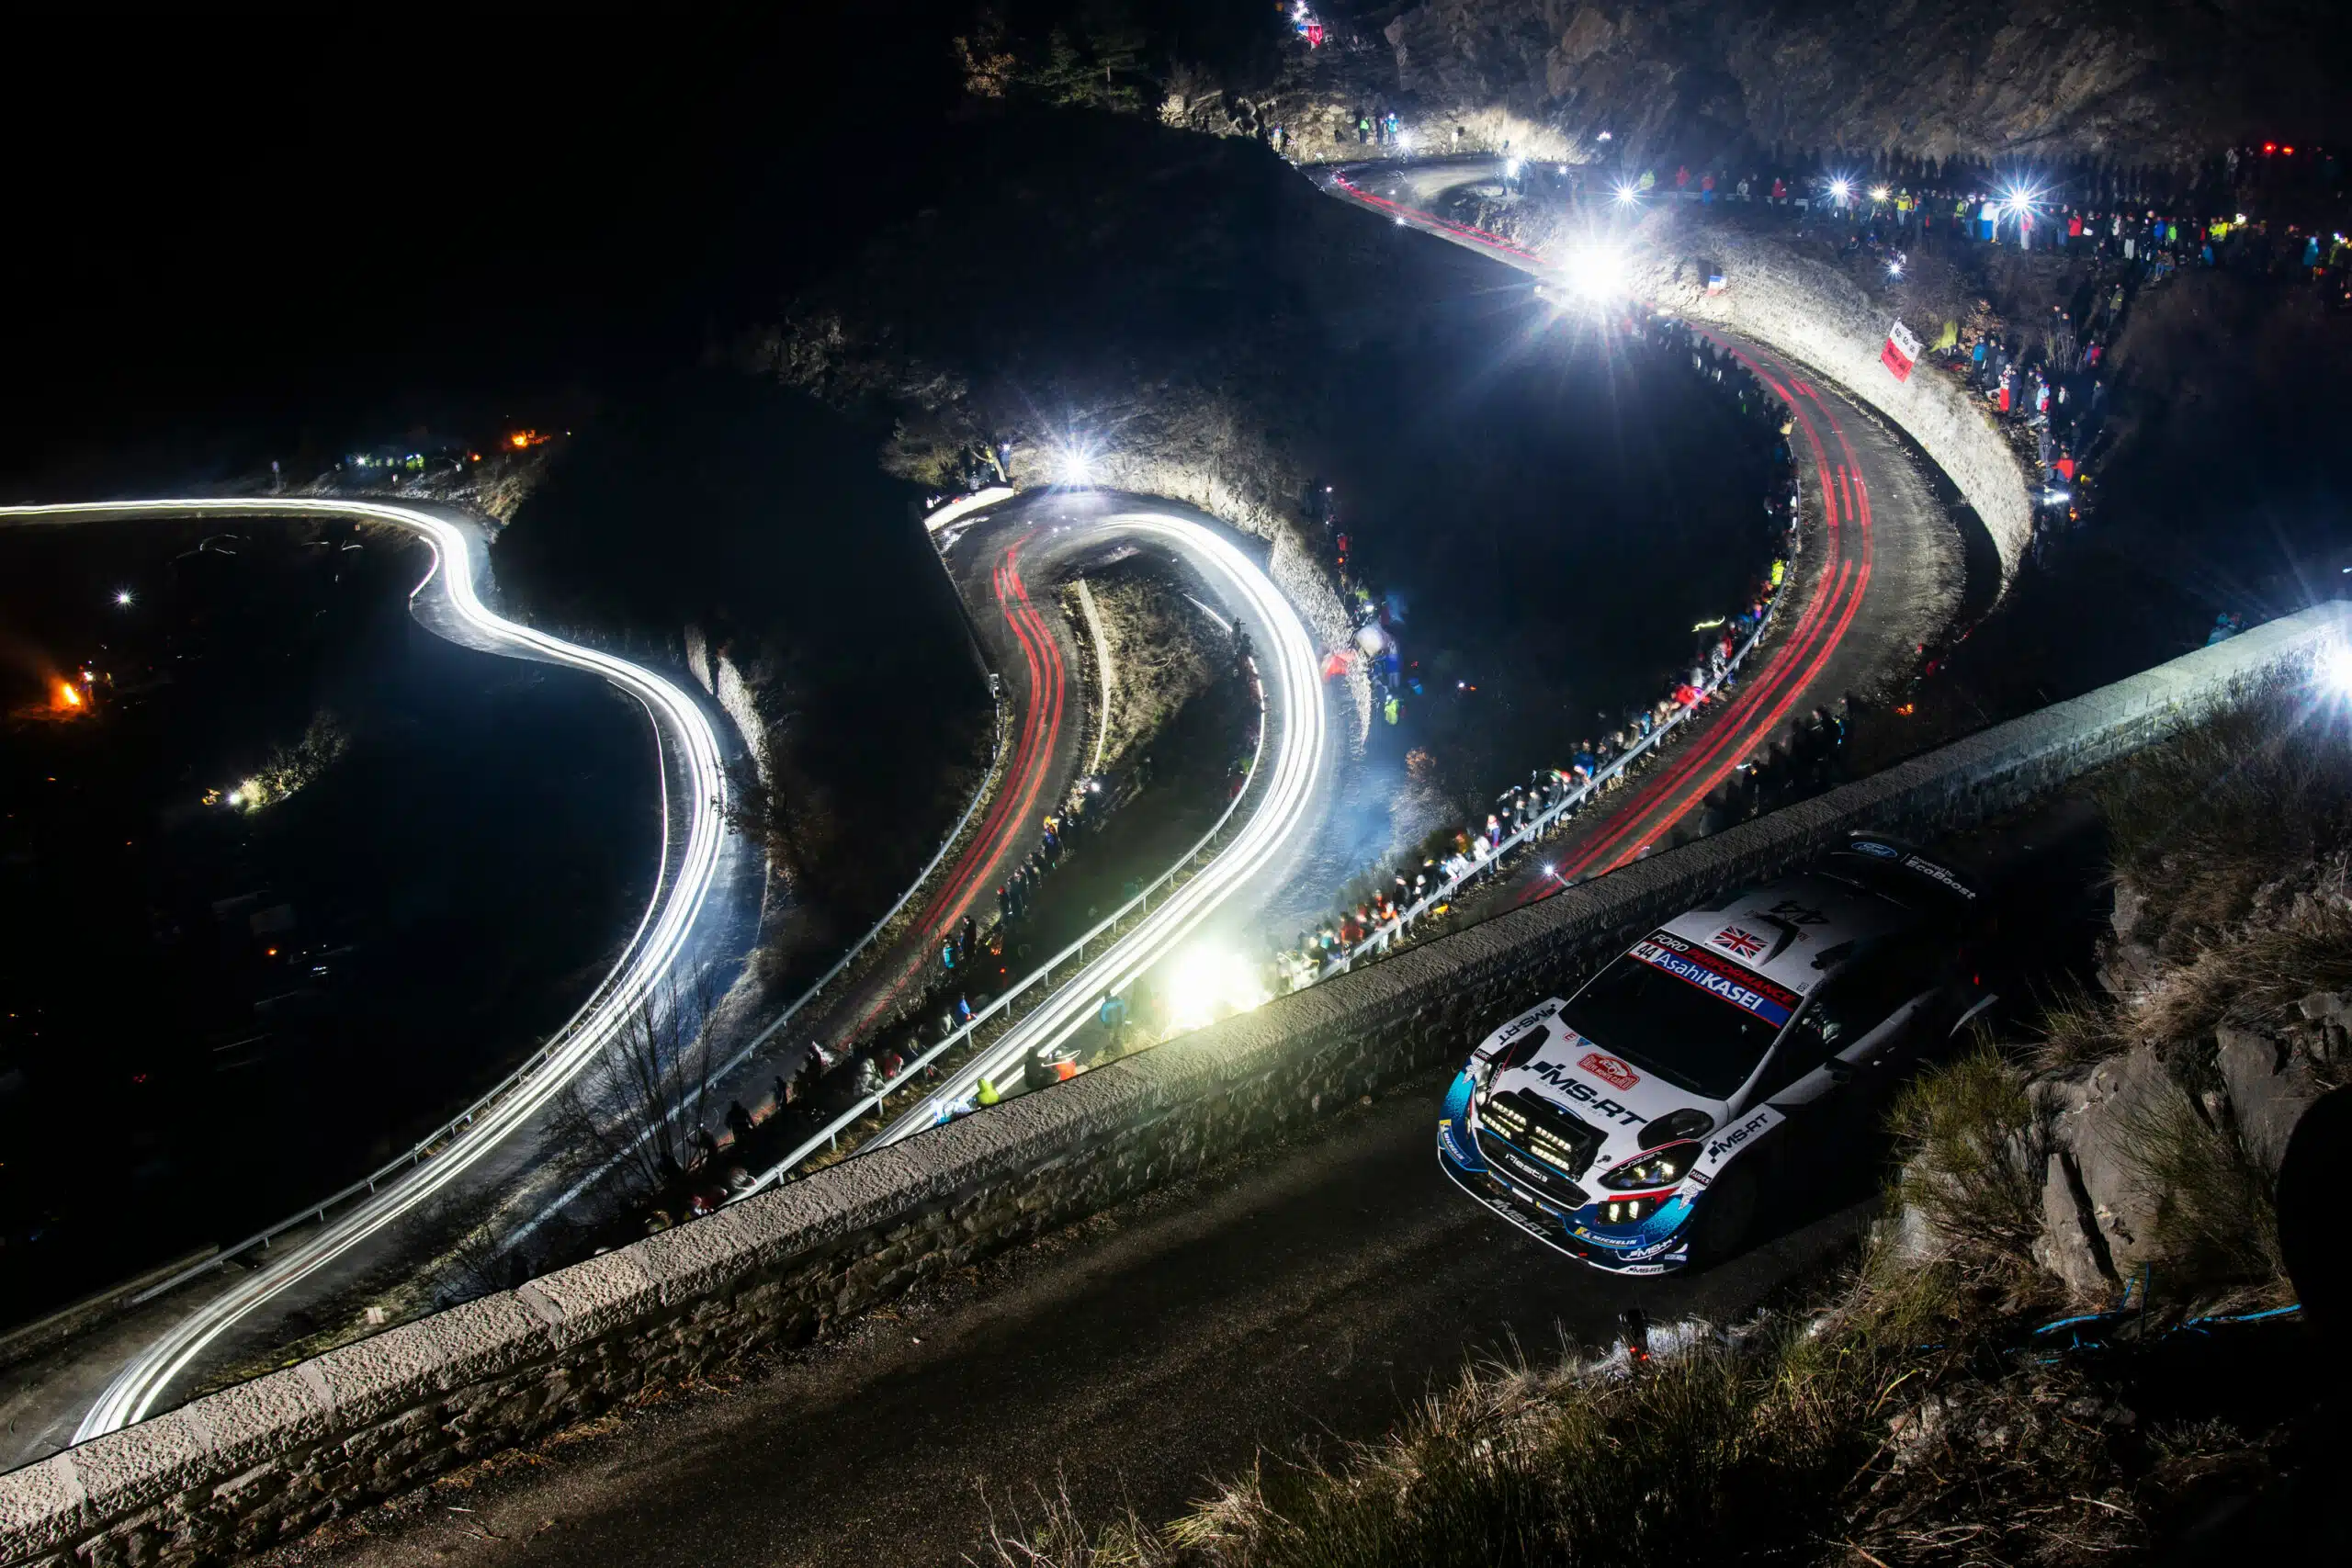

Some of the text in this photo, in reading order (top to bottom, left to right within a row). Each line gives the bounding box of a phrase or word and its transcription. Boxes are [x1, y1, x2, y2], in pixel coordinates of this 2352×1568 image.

[1635, 943, 1657, 960] 44
[1652, 933, 1796, 1003] FORD PERFORMANCE
[1592, 1235, 1637, 1245] MICHELIN
